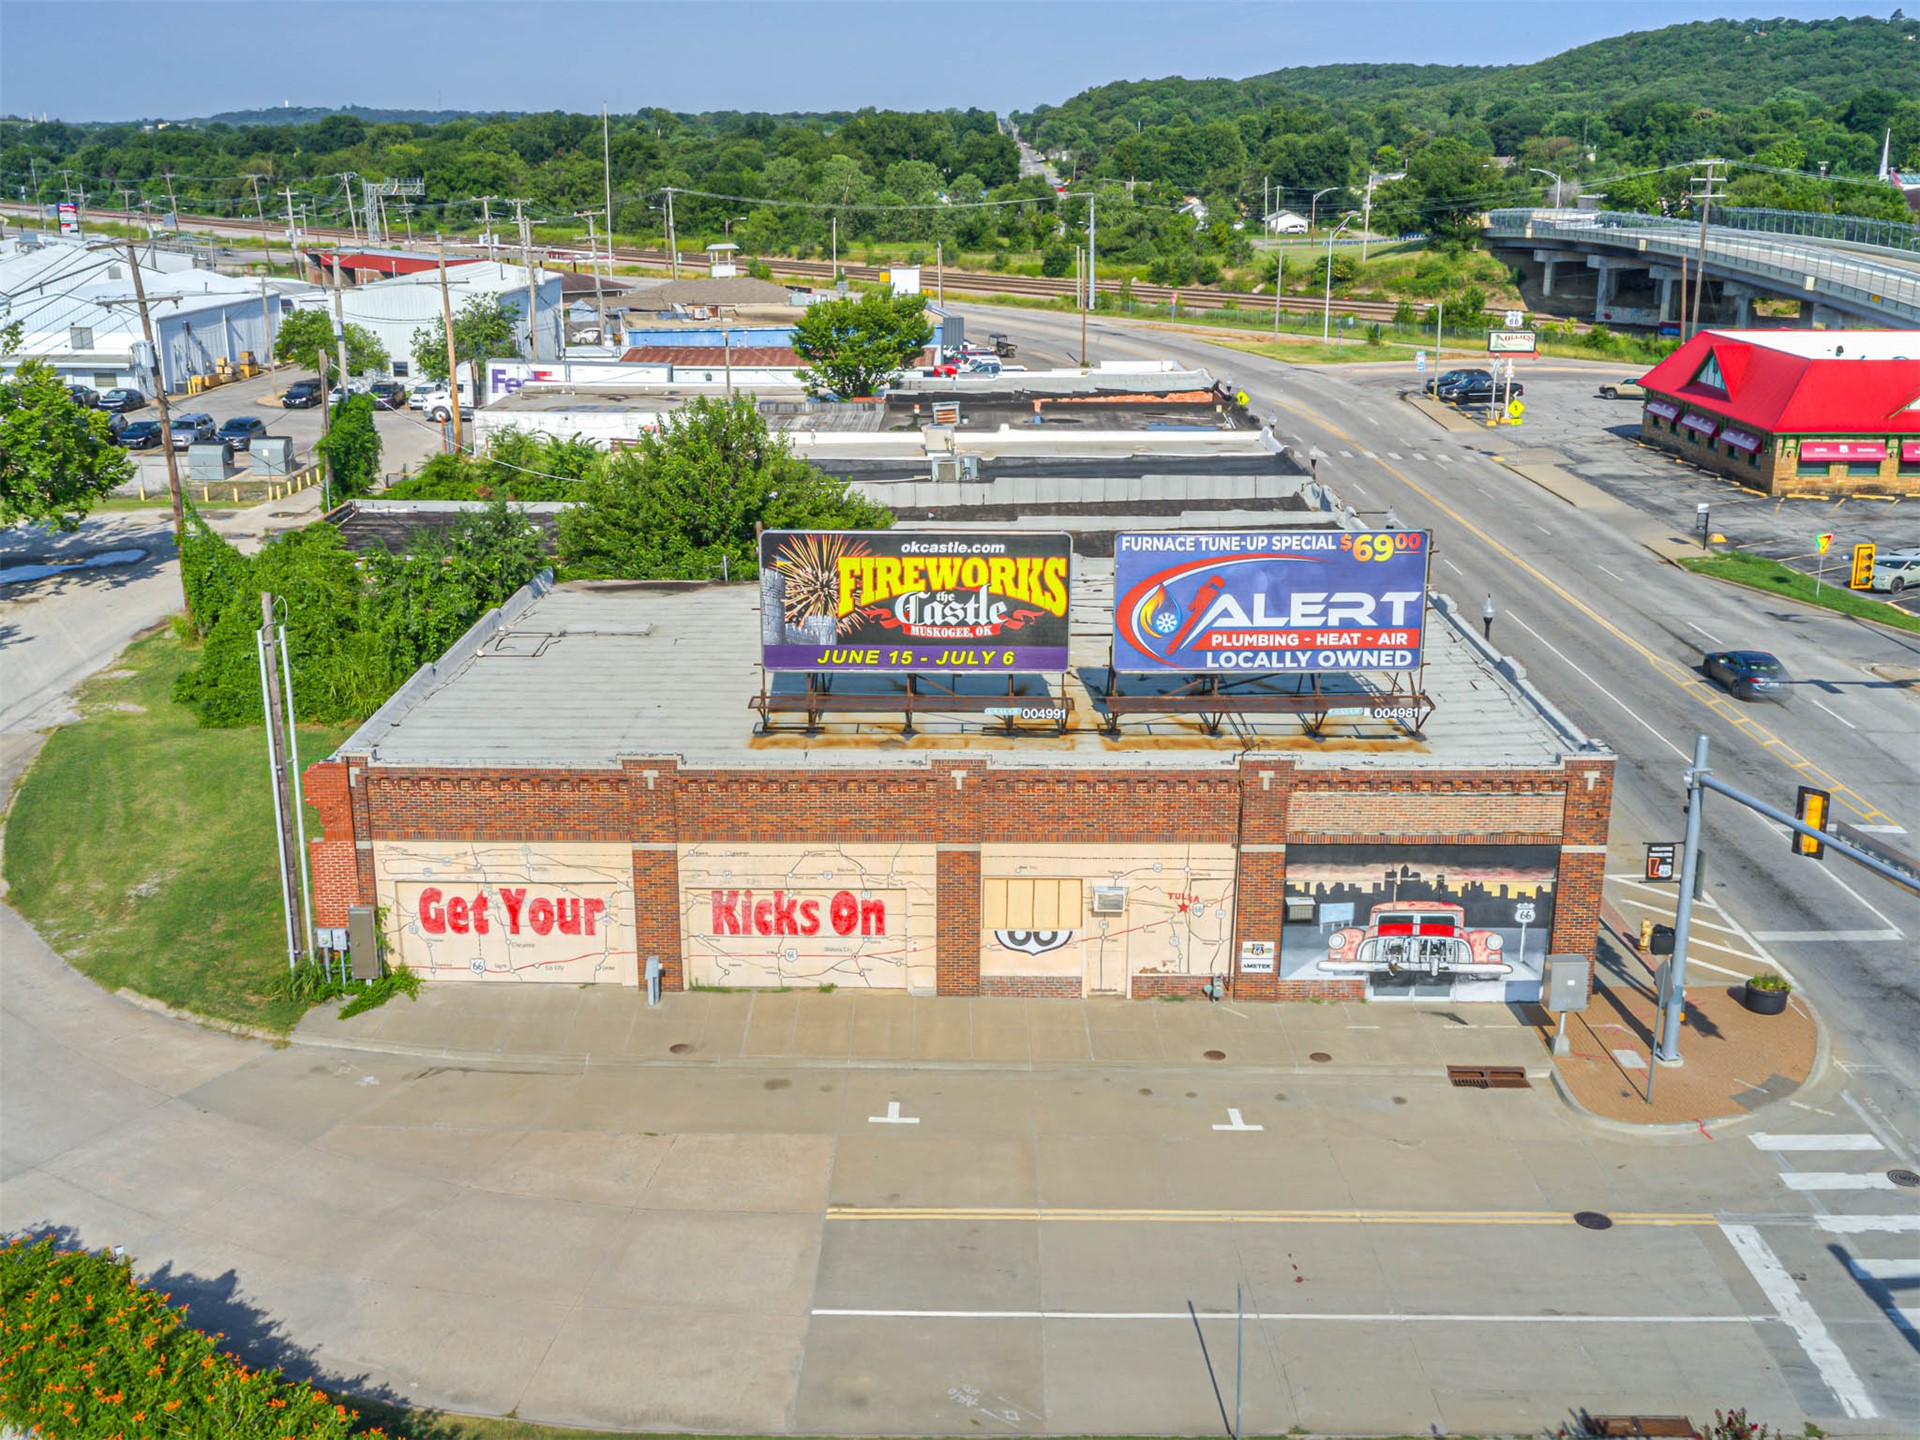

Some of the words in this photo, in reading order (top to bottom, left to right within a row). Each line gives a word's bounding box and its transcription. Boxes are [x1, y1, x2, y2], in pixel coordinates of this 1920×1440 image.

[901, 541, 1005, 554] okcastle.com
[1121, 536, 1195, 552] FURNACE
[1198, 536, 1266, 551] TUNE-UP
[1271, 535, 1337, 550] SPECIAL
[837, 556, 1069, 618] FIREWORKS
[935, 590, 955, 603] the
[894, 583, 1009, 626] Castle
[1185, 592, 1422, 635] ALERT
[910, 625, 973, 638] MUSKOGEE,
[975, 625, 992, 636] OK
[1211, 633, 1299, 647] PLUMBING
[1316, 633, 1362, 646] HEAT
[1377, 632, 1408, 646] AIR
[817, 649, 880, 665] JUNE
[889, 649, 913, 665] 15
[935, 649, 996, 665] JULY
[1001, 649, 1015, 665] 6
[1206, 651, 1311, 668] LOCALLY
[1317, 650, 1412, 668] OWNED
[1022, 708, 1066, 719] 004991
[1374, 707, 1418, 718] 004981
[1167, 892, 1200, 904] TULSA
[418, 887, 490, 935] Get
[498, 888, 605, 936] Your
[711, 889, 820, 936] Kicks
[830, 890, 886, 936] On
[1520, 910, 1532, 920] 66
[472, 961, 484, 971] 66
